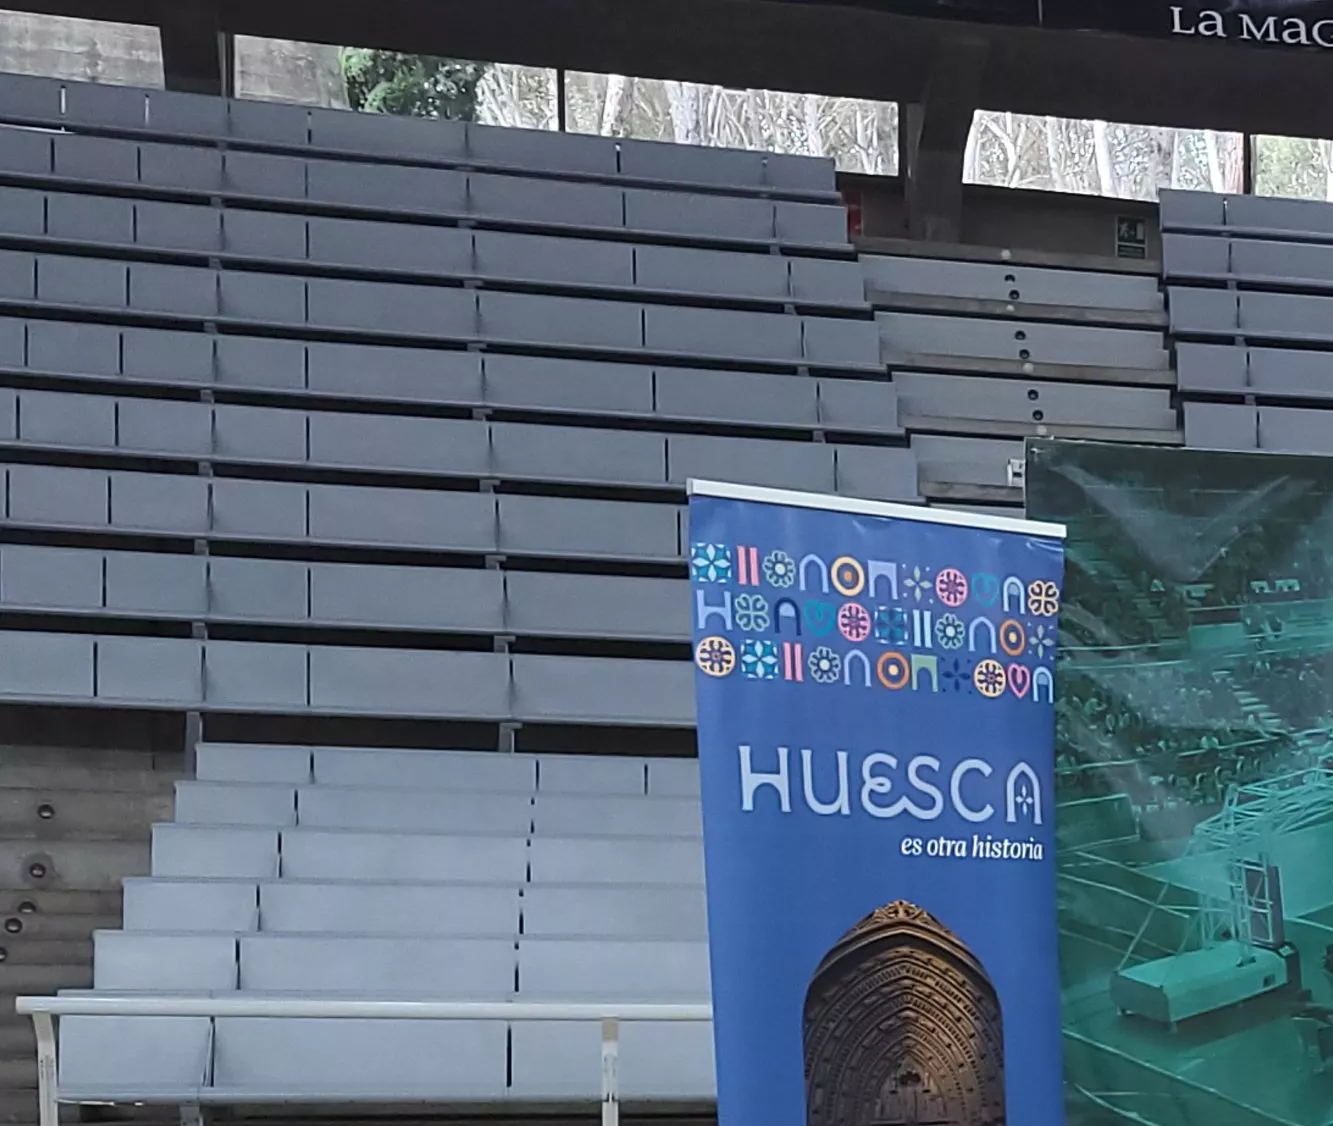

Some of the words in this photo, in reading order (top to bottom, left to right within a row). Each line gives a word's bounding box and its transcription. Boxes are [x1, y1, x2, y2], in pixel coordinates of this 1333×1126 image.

[738, 744, 1043, 825] HUESCA
[901, 836, 924, 856] es
[927, 837, 967, 858] otra
[972, 834, 1043, 861] historia
